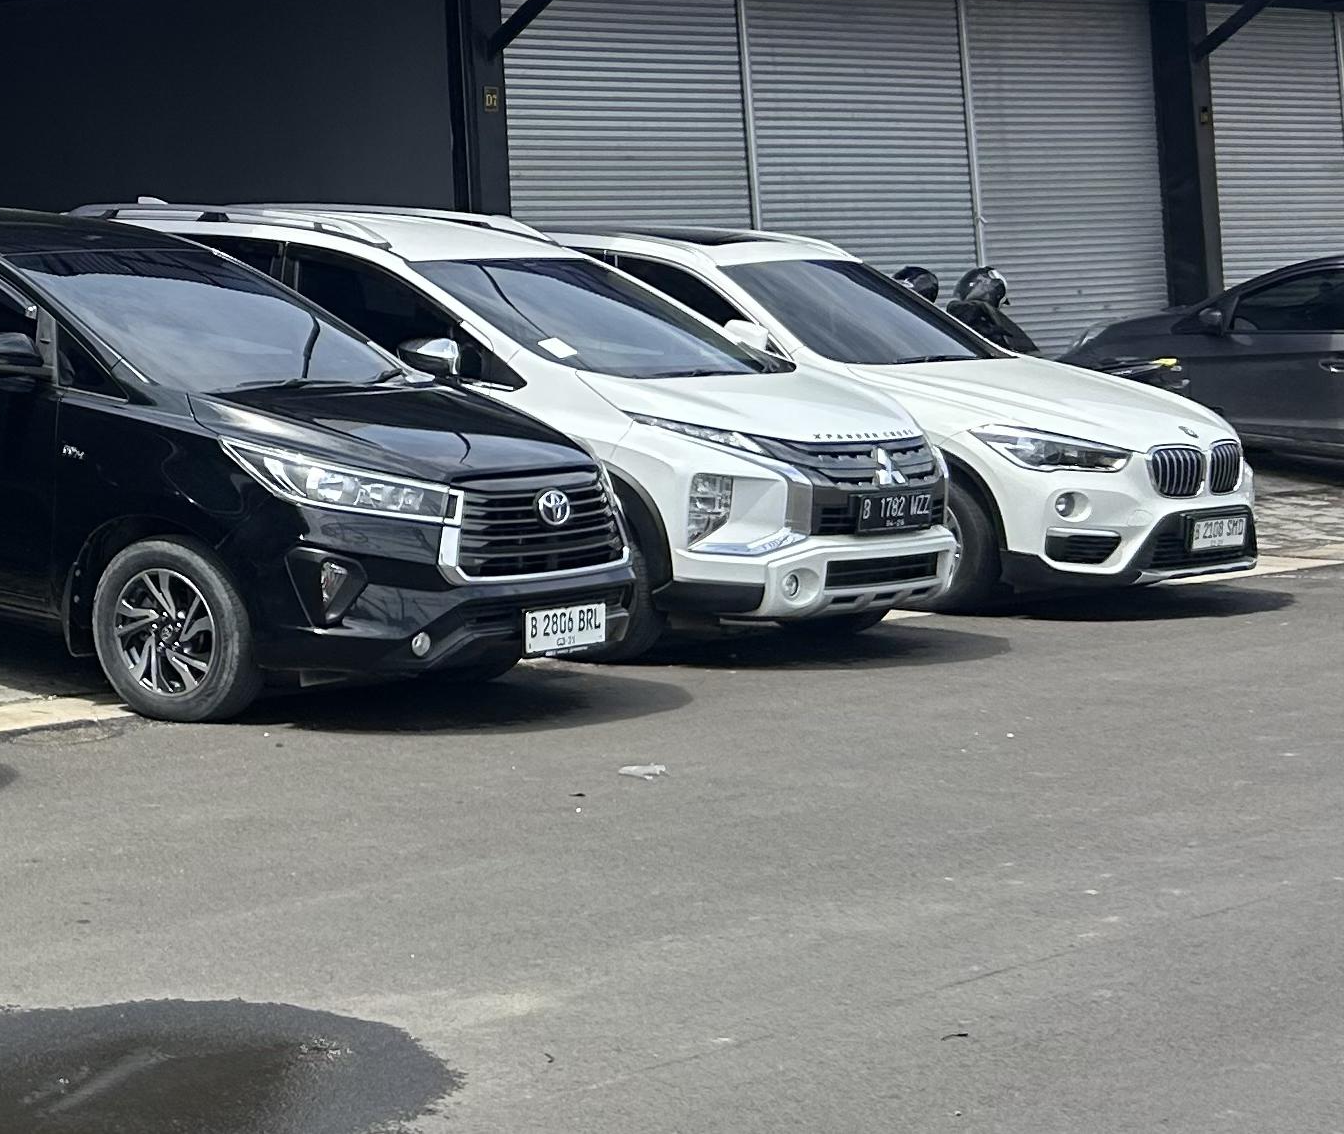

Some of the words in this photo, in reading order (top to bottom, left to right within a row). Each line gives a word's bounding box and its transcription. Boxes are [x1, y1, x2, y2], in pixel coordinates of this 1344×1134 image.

[862, 498, 873, 521] B
[530, 615, 539, 639] B
[542, 610, 575, 638] 2806
[577, 607, 602, 633] BRL
